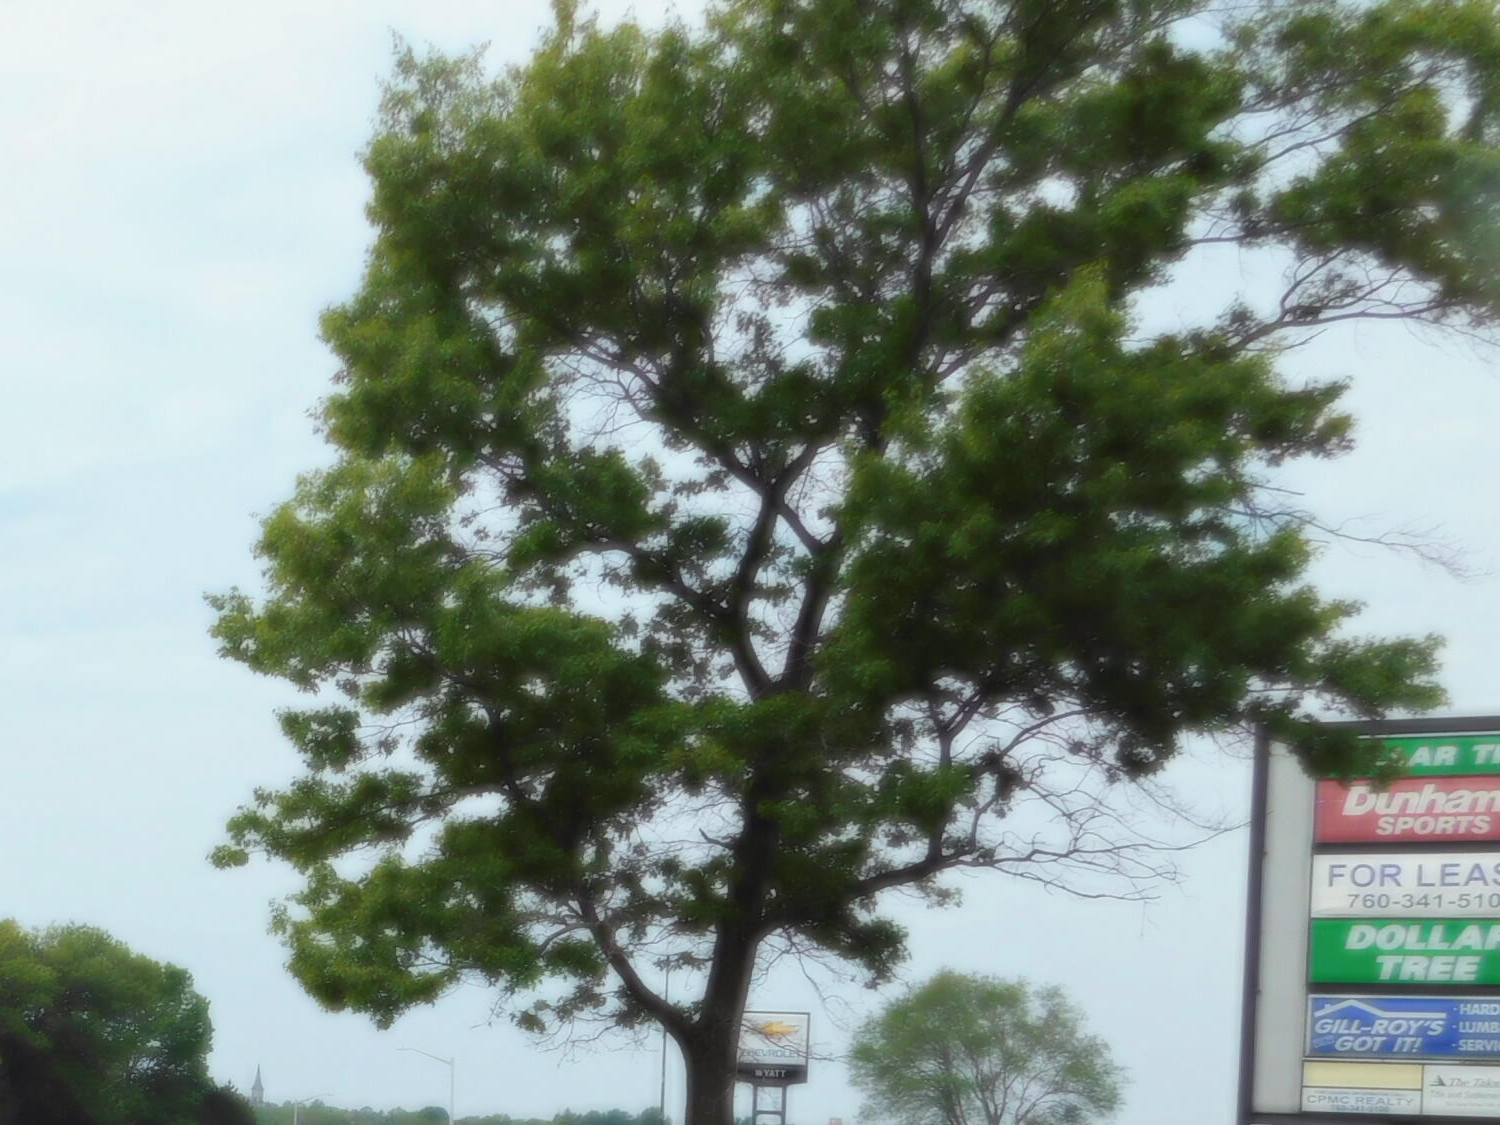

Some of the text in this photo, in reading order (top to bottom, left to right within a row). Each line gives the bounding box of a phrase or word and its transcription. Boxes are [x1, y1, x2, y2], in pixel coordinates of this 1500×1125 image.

[1375, 815, 1492, 836] SPORTS
[1328, 864, 1402, 887] FOR
[1347, 892, 1500, 908] 760-341-510
[1376, 955, 1482, 981] TREE
[1314, 1018, 1445, 1036] GILL-ROY'S
[1334, 1036, 1387, 1052] GOT
[1392, 1037, 1423, 1052] IT!
[755, 1069, 787, 1078] WYATT
[1307, 1094, 1414, 1106] CPMC REALTY
